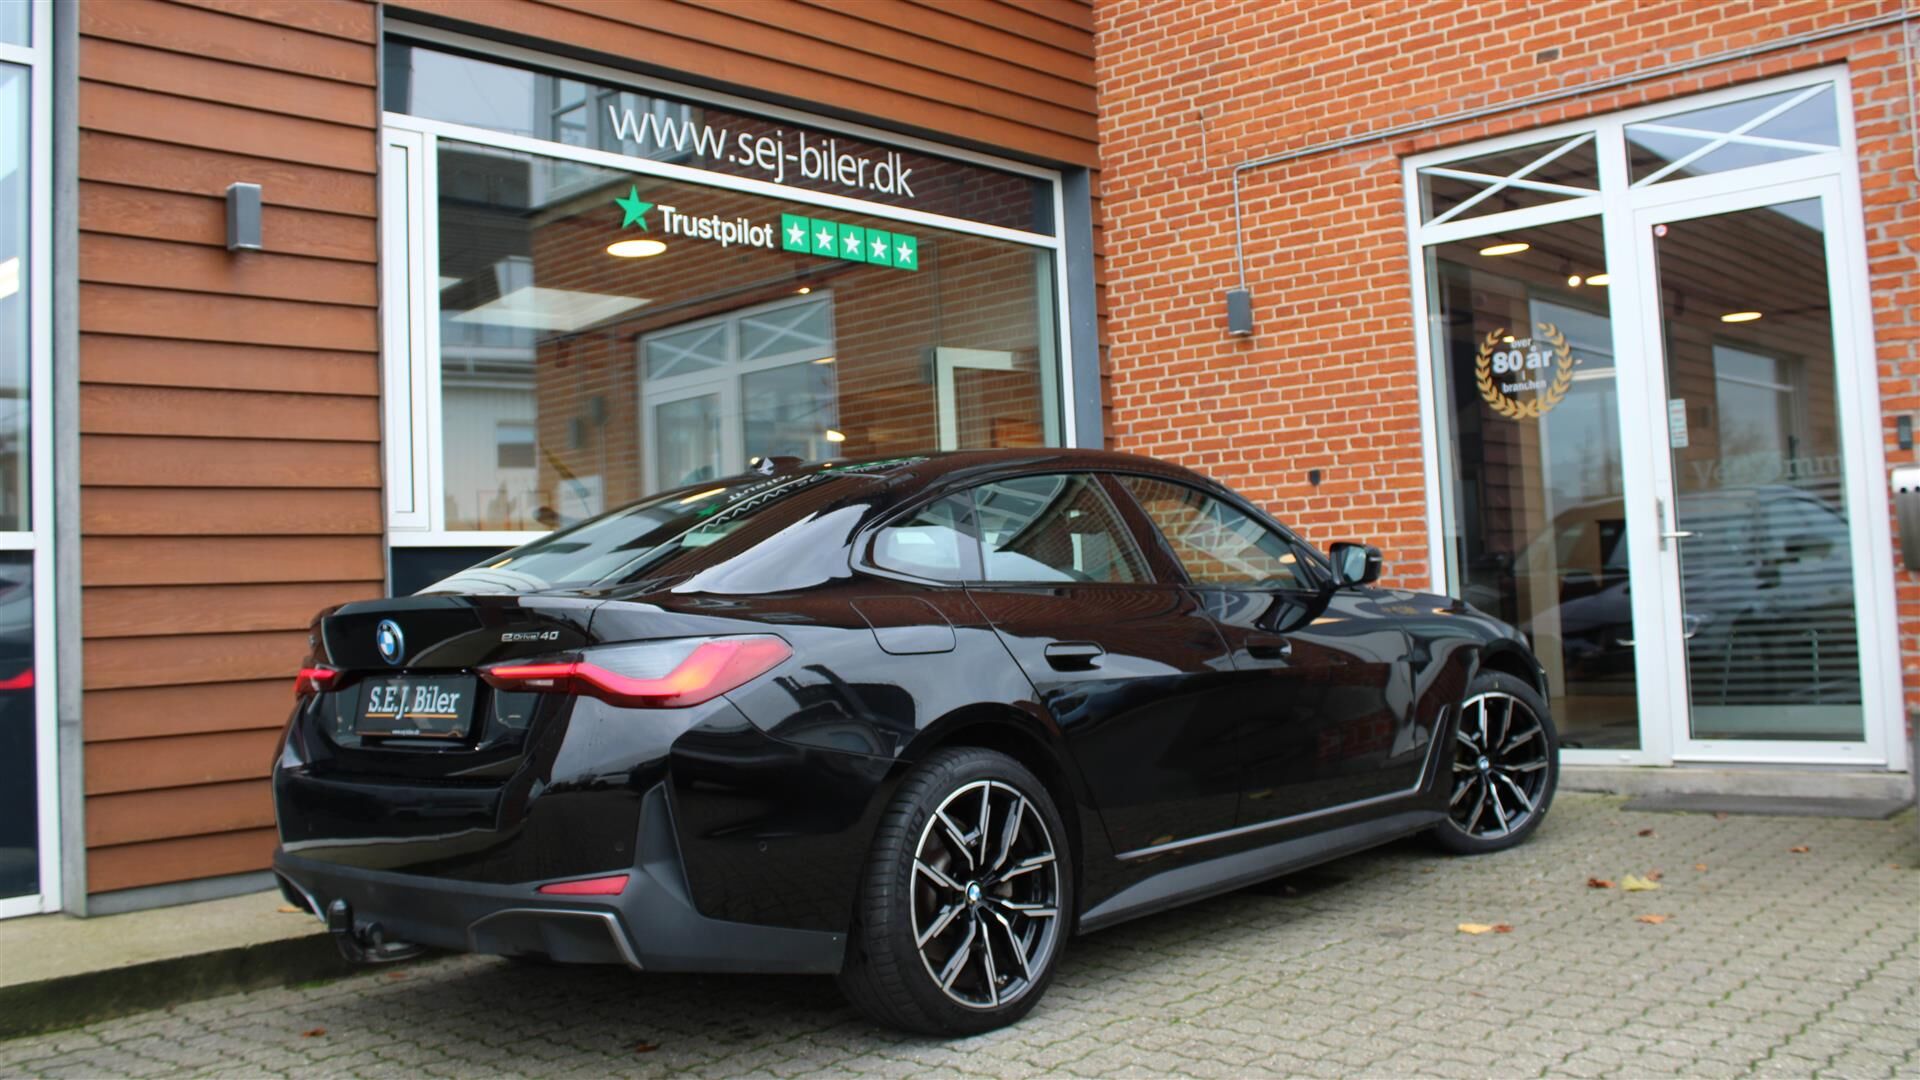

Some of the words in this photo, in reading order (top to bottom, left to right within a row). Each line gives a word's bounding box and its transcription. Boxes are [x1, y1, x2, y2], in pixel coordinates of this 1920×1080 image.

[609, 104, 915, 198] www.sej-biler.dk
[657, 204, 774, 249] Trustpilot
[1492, 350, 1523, 373] 80
[1526, 345, 1553, 369] år
[1502, 379, 1547, 393] branchen
[540, 631, 559, 641] 40
[368, 686, 409, 720] S.E.J.
[412, 686, 460, 713] Biler
